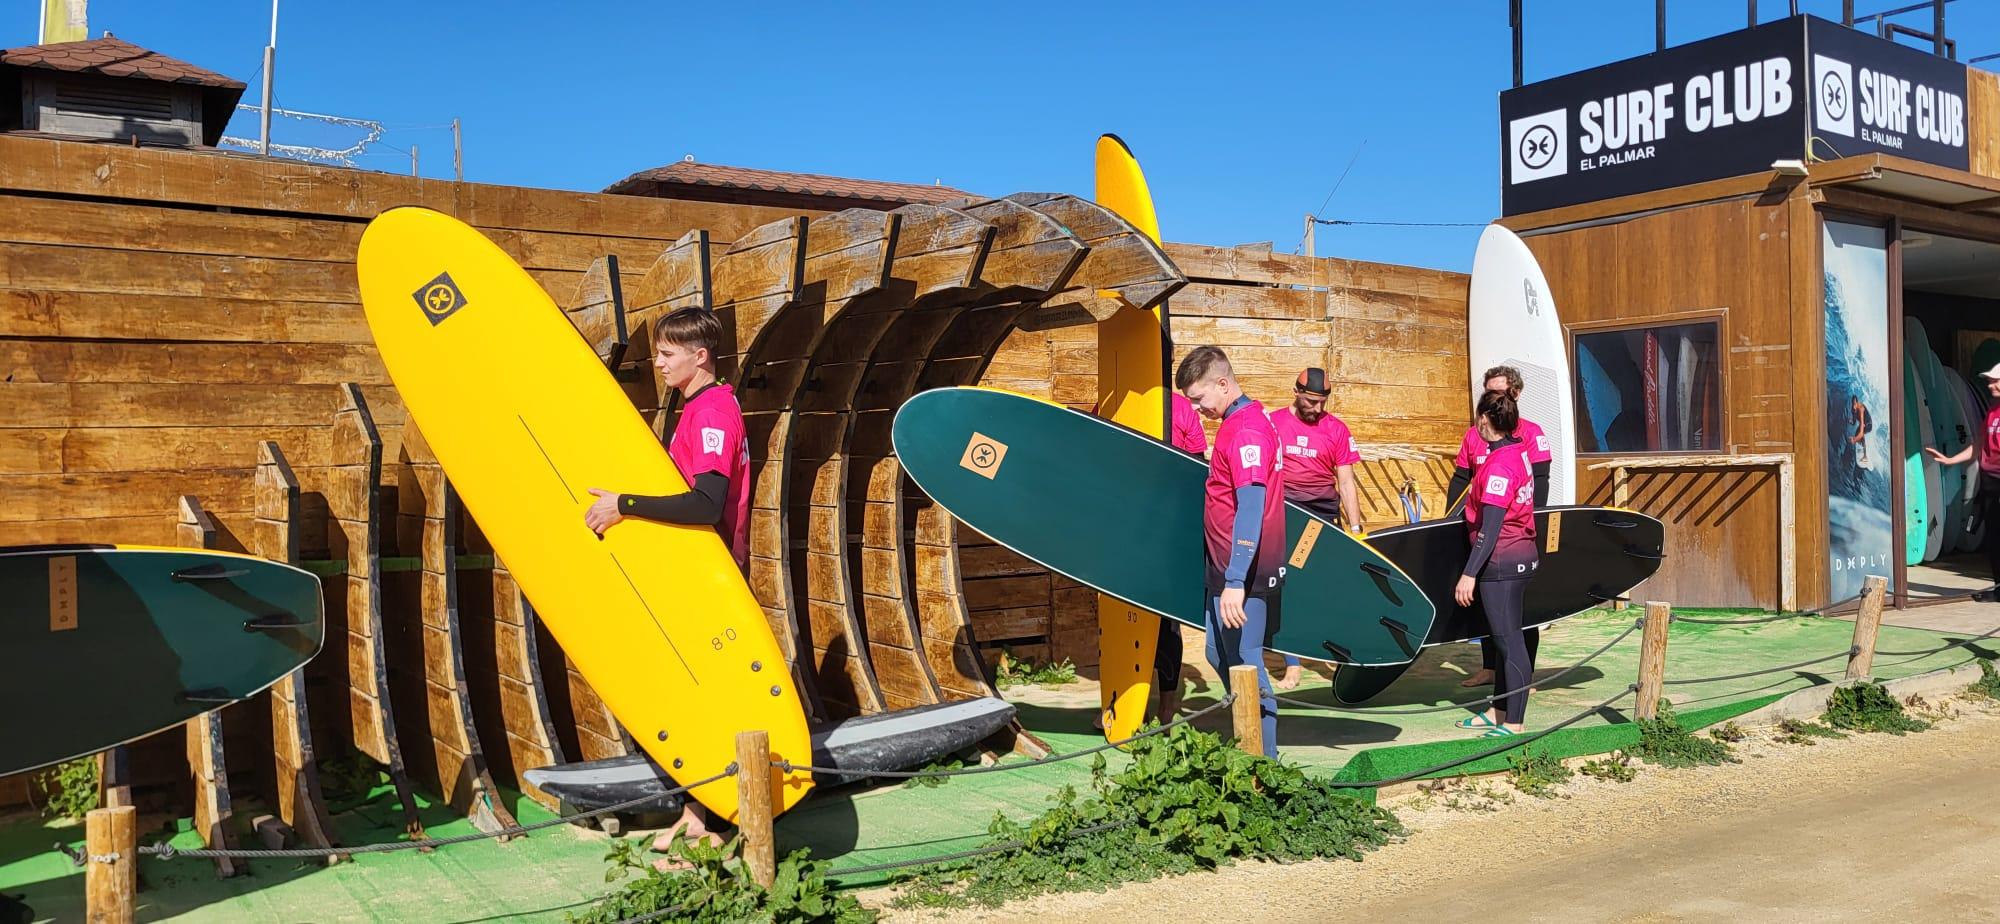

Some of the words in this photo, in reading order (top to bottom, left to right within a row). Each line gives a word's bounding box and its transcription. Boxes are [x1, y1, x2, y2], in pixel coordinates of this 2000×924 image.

[1579, 82, 1674, 155] SURF
[1685, 56, 1793, 133] CLUB
[1859, 67, 1911, 134] SURF
[1915, 84, 1964, 147] CLUB
[1580, 158, 1597, 171] EL
[1599, 146, 1656, 168] PALMAR
[1862, 128, 1871, 142] EL
[1872, 131, 1902, 150] PALMAR
